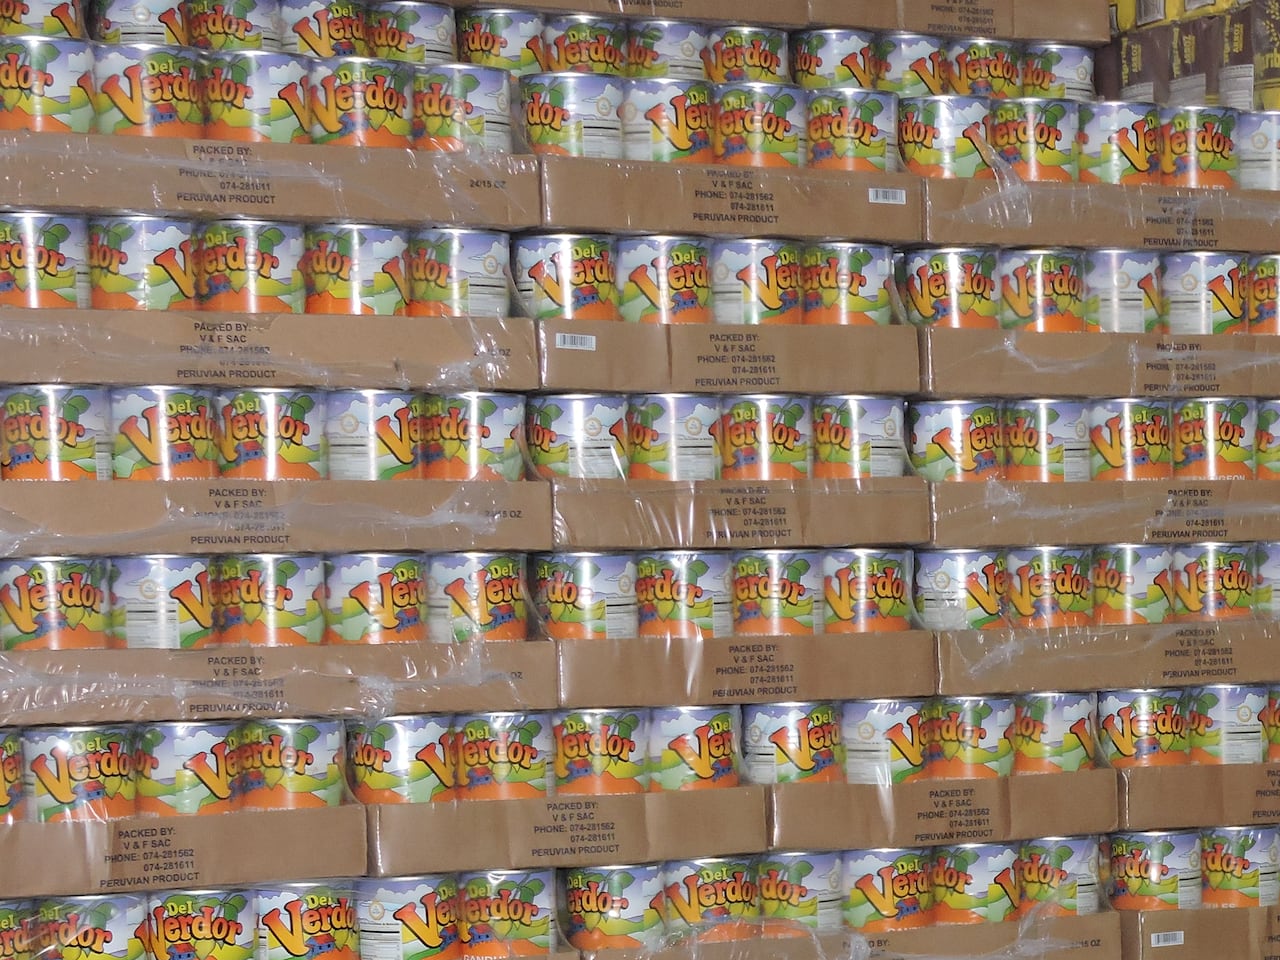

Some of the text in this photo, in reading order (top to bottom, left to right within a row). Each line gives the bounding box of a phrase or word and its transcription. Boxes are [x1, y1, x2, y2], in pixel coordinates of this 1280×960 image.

[725, 36, 745, 48] Del
[147, 60, 175, 76] Del
[235, 399, 260, 414] Del
[734, 407, 756, 421] Del
[209, 489, 266, 497] PACKED BY:
[191, 536, 290, 544] PERUVIAN PRODUCT
[728, 644, 778, 653] PACKED BY:
[712, 686, 797, 697] PERUVIAN PRODUCT
[565, 720, 590, 734] Del
[929, 788, 975, 798] PACKED BY:
[119, 827, 175, 839] PACKED BY:
[915, 829, 993, 841] PERUVIAN PRODUCT
[143, 840, 149, 848] F
[151, 839, 171, 848] SAC
[104, 849, 194, 864] PHONE: 074-281562
[532, 845, 619, 856] PERUVIAN PRODUCT
[144, 861, 194, 872] 074-281611
[100, 872, 199, 888] PERUVIAN PRODUCT
[305, 894, 332, 909] Del
[166, 901, 193, 916] Del
